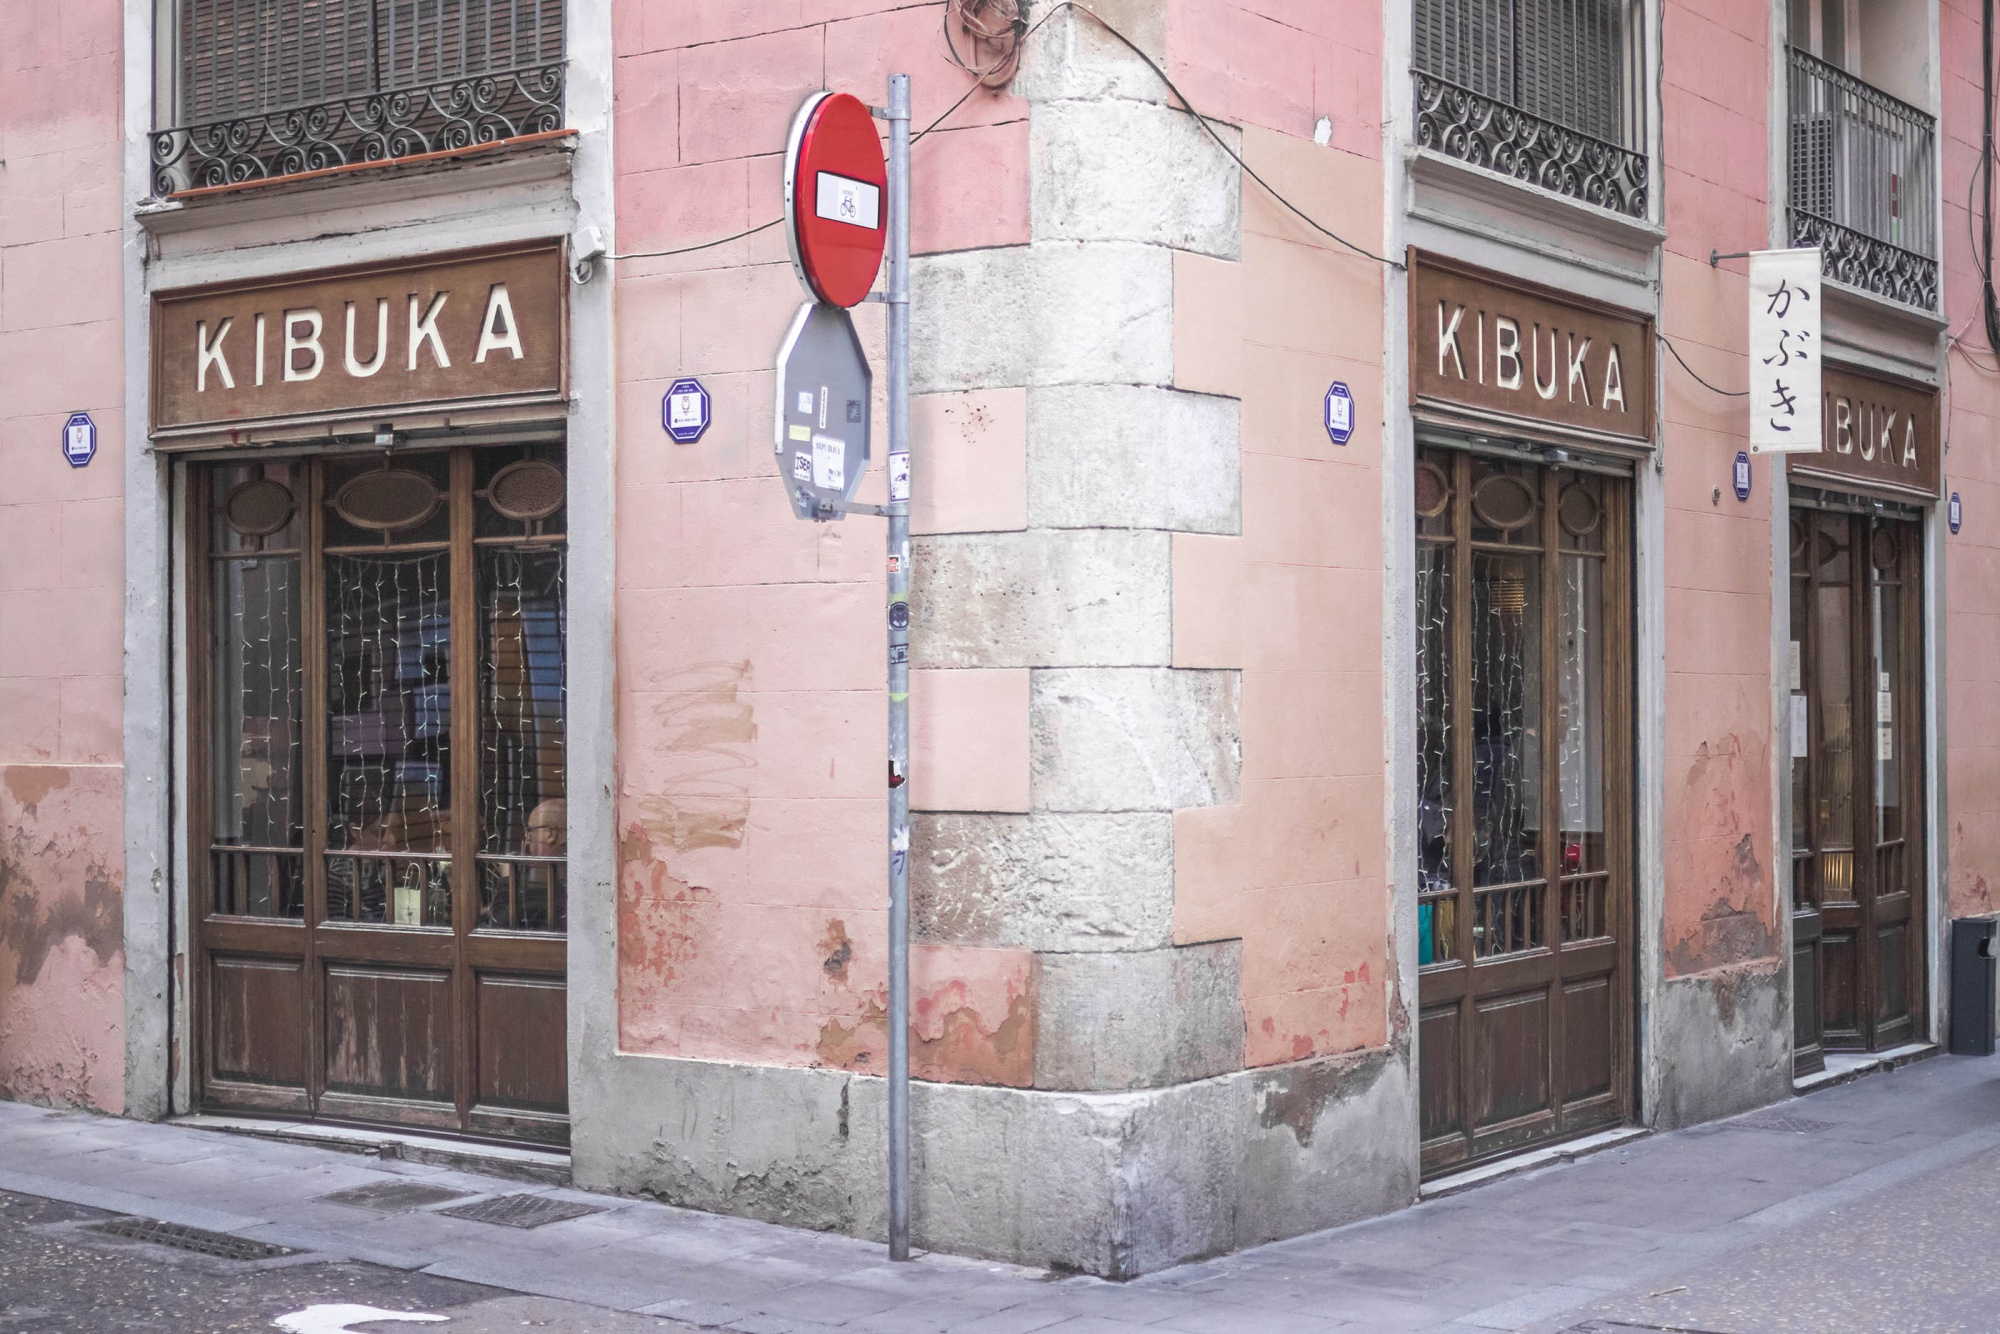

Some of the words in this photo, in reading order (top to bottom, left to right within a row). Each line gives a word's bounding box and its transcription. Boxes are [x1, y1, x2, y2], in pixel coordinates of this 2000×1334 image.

[196, 282, 524, 392] KIBUKA
[1438, 300, 1628, 413] KIBUKA
[1763, 279, 1811, 432] かぶき
[1825, 391, 1919, 470] IBUKA
